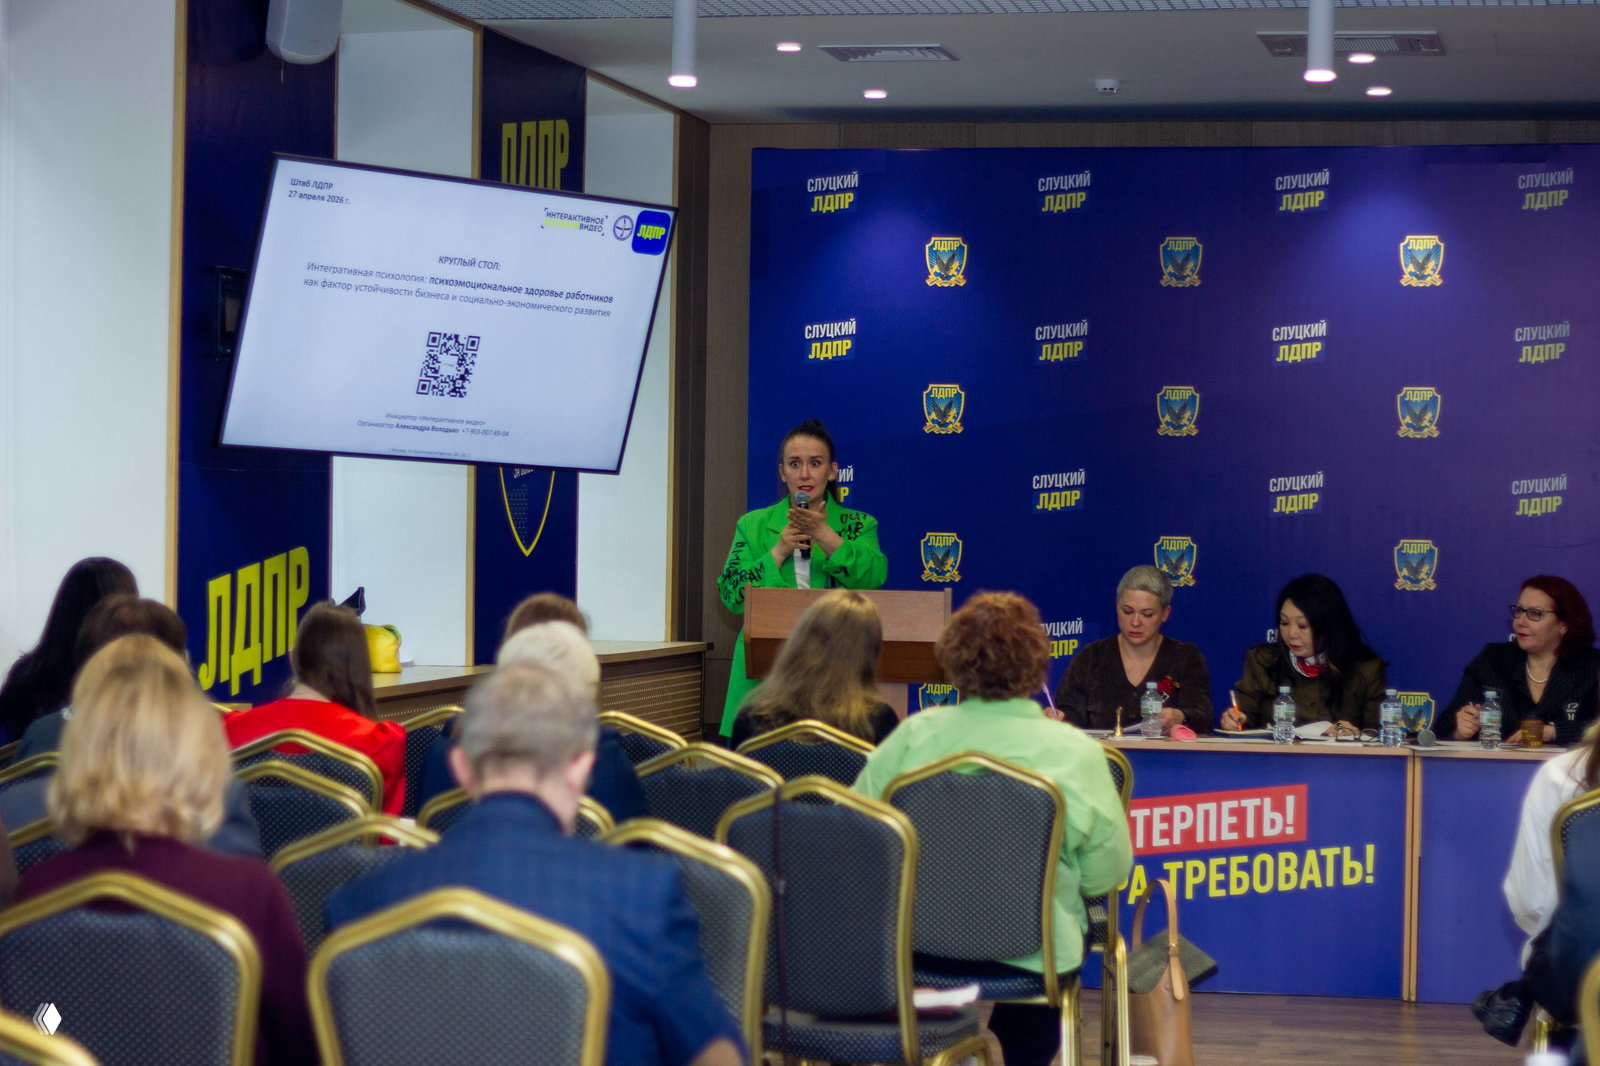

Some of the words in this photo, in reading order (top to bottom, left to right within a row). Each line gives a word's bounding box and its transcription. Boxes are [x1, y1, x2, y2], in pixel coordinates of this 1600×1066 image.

[290, 178, 311, 187] Штаб
[312, 181, 334, 191] ЛДПР
[807, 171, 859, 193] СЛУЦКИЙ
[1038, 170, 1092, 193] СЛУЦКИЙ
[1275, 169, 1330, 191] СЛУЦКИЙ
[1518, 168, 1573, 190] СЛУЦКИЙ
[288, 190, 298, 198] 27
[298, 192, 325, 201] апреля
[326, 195, 345, 204] 2026
[810, 193, 855, 213] ЛДПР
[1041, 192, 1087, 213] ЛДПР
[1278, 191, 1326, 212] ЛДПР
[1522, 190, 1569, 211] ЛДПР
[546, 211, 605, 225] ИНТЕРАКТИВНОЕ
[579, 223, 603, 233] ВИДЕО
[636, 224, 666, 240] ЛДПР
[932, 239, 960, 253] ЛДПР
[1167, 239, 1195, 253] ЛДПР
[1407, 238, 1436, 252] ЛДПР
[438, 255, 476, 268] КРУГЛЫЙ
[478, 260, 501, 271] СТОЛ:
[307, 261, 373, 278] Интегративная
[375, 271, 428, 283] психология:
[429, 276, 523, 294] психоэмоциональное
[524, 285, 564, 299] здоровье
[565, 290, 614, 304] работников
[303, 278, 319, 287] как
[320, 278, 352, 291] фактор
[354, 283, 413, 297] устойчивости
[415, 288, 450, 301] бизнеса
[460, 294, 573, 314] социально-экономического
[574, 306, 611, 318] развития
[804, 318, 857, 340] СЛУЦКИЙ
[1035, 320, 1089, 342] СЛУЦКИЙ
[1272, 320, 1327, 343] СЛУЦКИЙ
[1514, 321, 1570, 343] СЛУЦКИЙ
[808, 340, 853, 361] ЛДПР
[1038, 341, 1084, 362] ЛДПР
[1276, 342, 1322, 363] ЛДПР
[1518, 343, 1566, 364] ЛДПР
[930, 387, 957, 400] ЛДПР
[1164, 388, 1192, 402] ЛДПР
[1404, 389, 1433, 403] ЛДПР
[395, 423, 430, 432] Александра
[1032, 469, 1086, 491] СЛУЦКИЙ
[1269, 471, 1324, 494] СЛУЦКИЙ
[1511, 474, 1567, 497] СЛУЦКИЙ
[1036, 490, 1081, 512] ЛДПР
[1273, 493, 1319, 514] ЛДПР
[1516, 496, 1563, 517] ЛДПР
[928, 536, 955, 549] ЛДПР
[1161, 539, 1190, 553] ЛДПР
[1401, 541, 1430, 555] ЛДПР
[199, 546, 310, 697] ЛДПР
[1040, 617, 1083, 637] УЦКИЙ
[1048, 639, 1079, 659] ДПР
[925, 683, 953, 695] ЛДПР
[1130, 795, 1295, 848] ТЕРПЕТЬ!
[1163, 844, 1375, 900] ТРЕБОВАТЬ!
